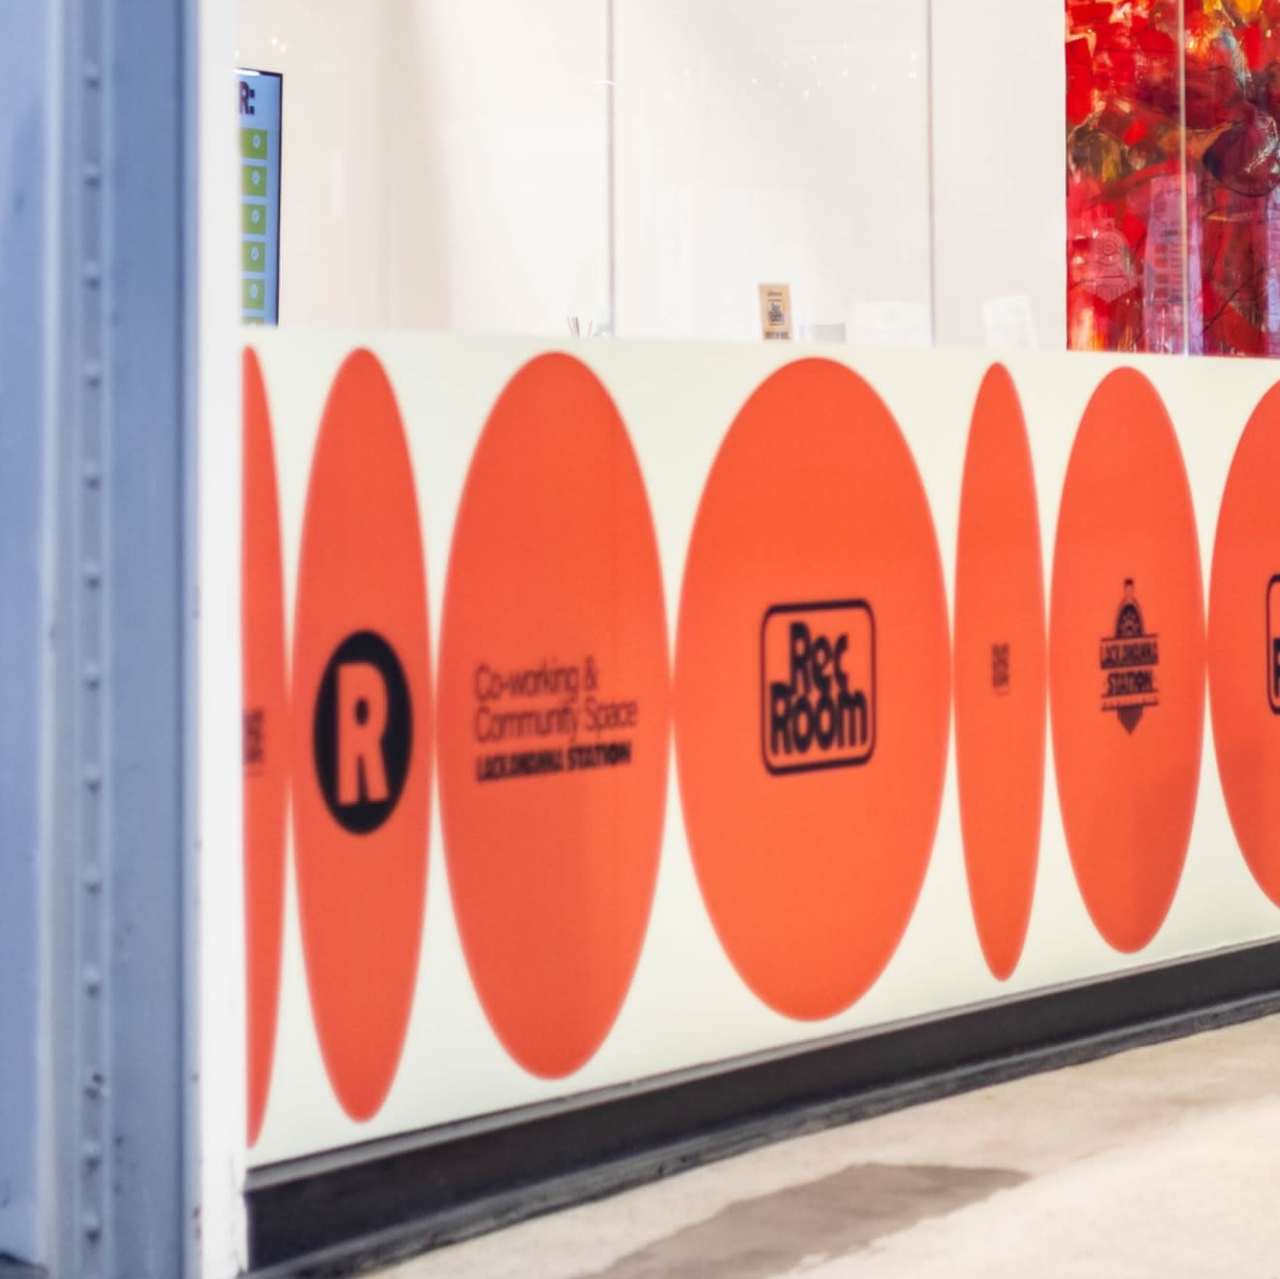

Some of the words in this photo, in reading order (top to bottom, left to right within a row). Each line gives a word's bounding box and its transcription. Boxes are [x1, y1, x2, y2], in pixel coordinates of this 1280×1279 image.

[475, 656, 580, 703] Co-working
[584, 654, 598, 691] &
[789, 621, 849, 694] Rec
[336, 661, 390, 807] R
[475, 701, 578, 745] Community
[584, 695, 638, 740] Space
[770, 682, 869, 756] Room
